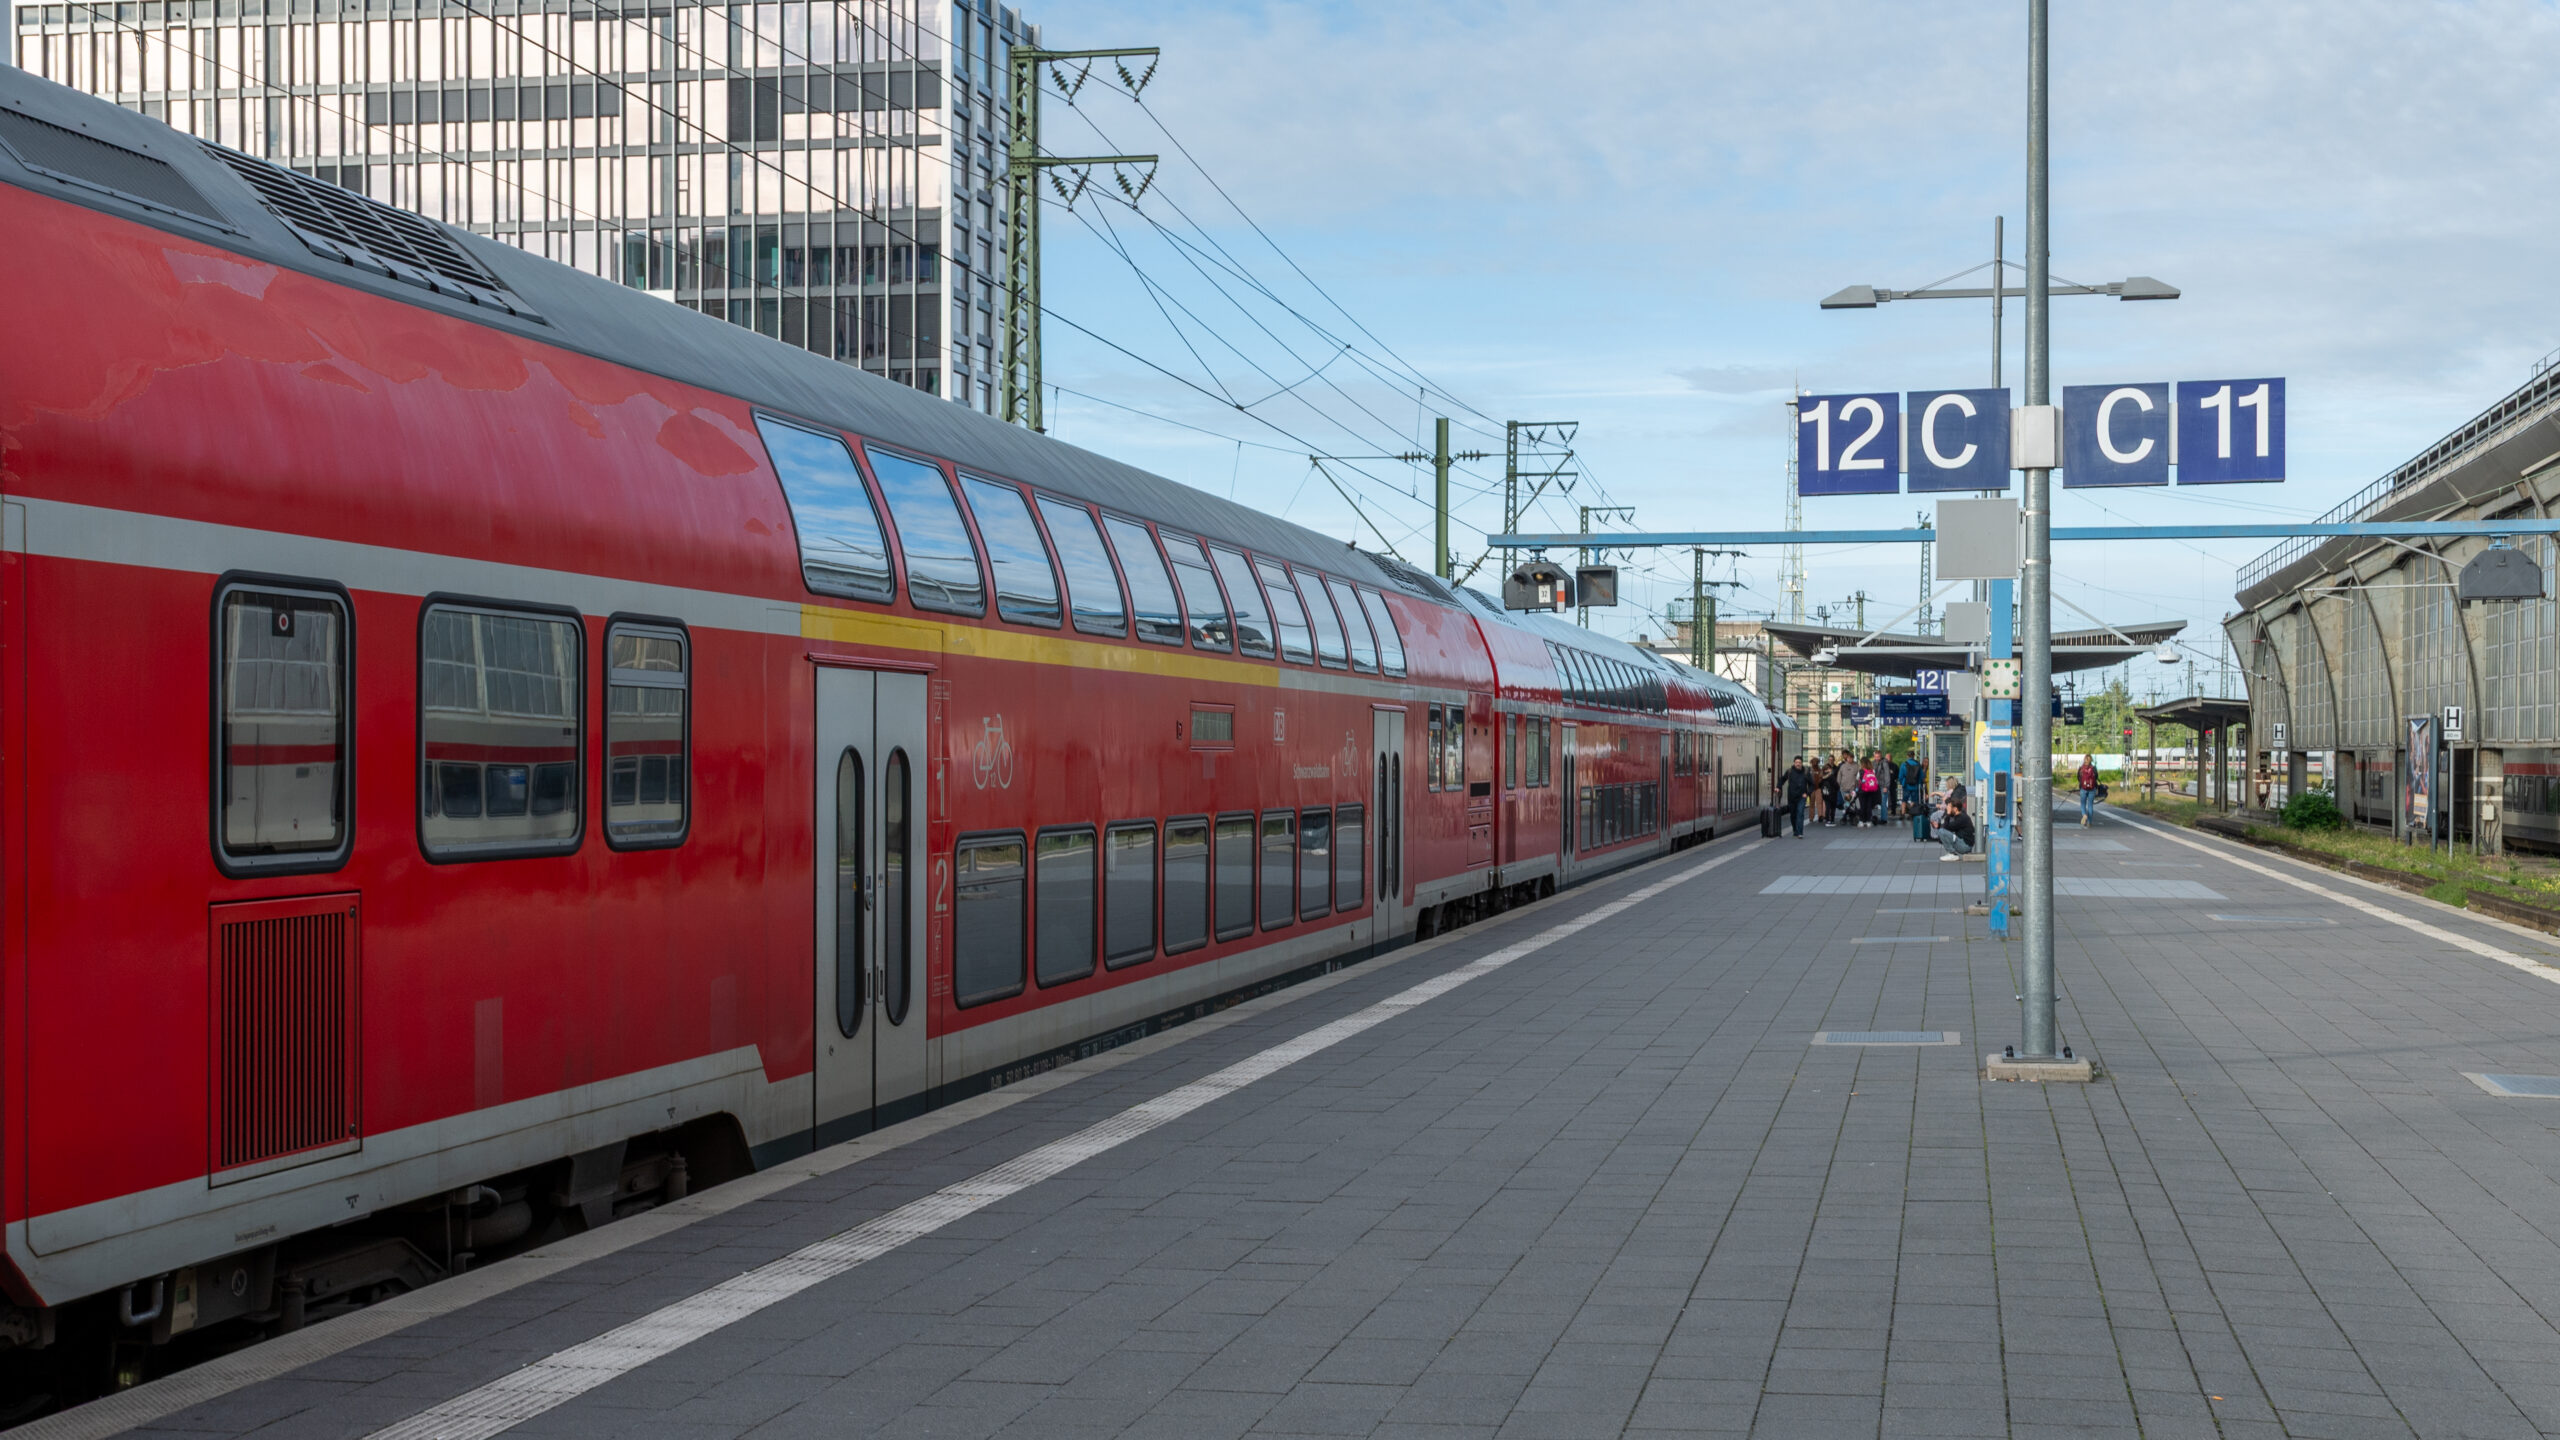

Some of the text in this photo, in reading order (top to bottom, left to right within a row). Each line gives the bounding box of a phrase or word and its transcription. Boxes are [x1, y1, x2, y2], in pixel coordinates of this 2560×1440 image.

[1800, 393, 1978, 472] 12 C
[2095, 383, 2270, 465] C 11
[1917, 670, 1939, 690] 12
[1274, 713, 1285, 740] DB
[2445, 708, 2460, 728] H
[2274, 724, 2284, 739] H
[990, 772, 997, 788] 12
[1293, 763, 1330, 779] Schwarzwaldbahn
[936, 763, 945, 817] 1
[935, 858, 948, 912] 2
